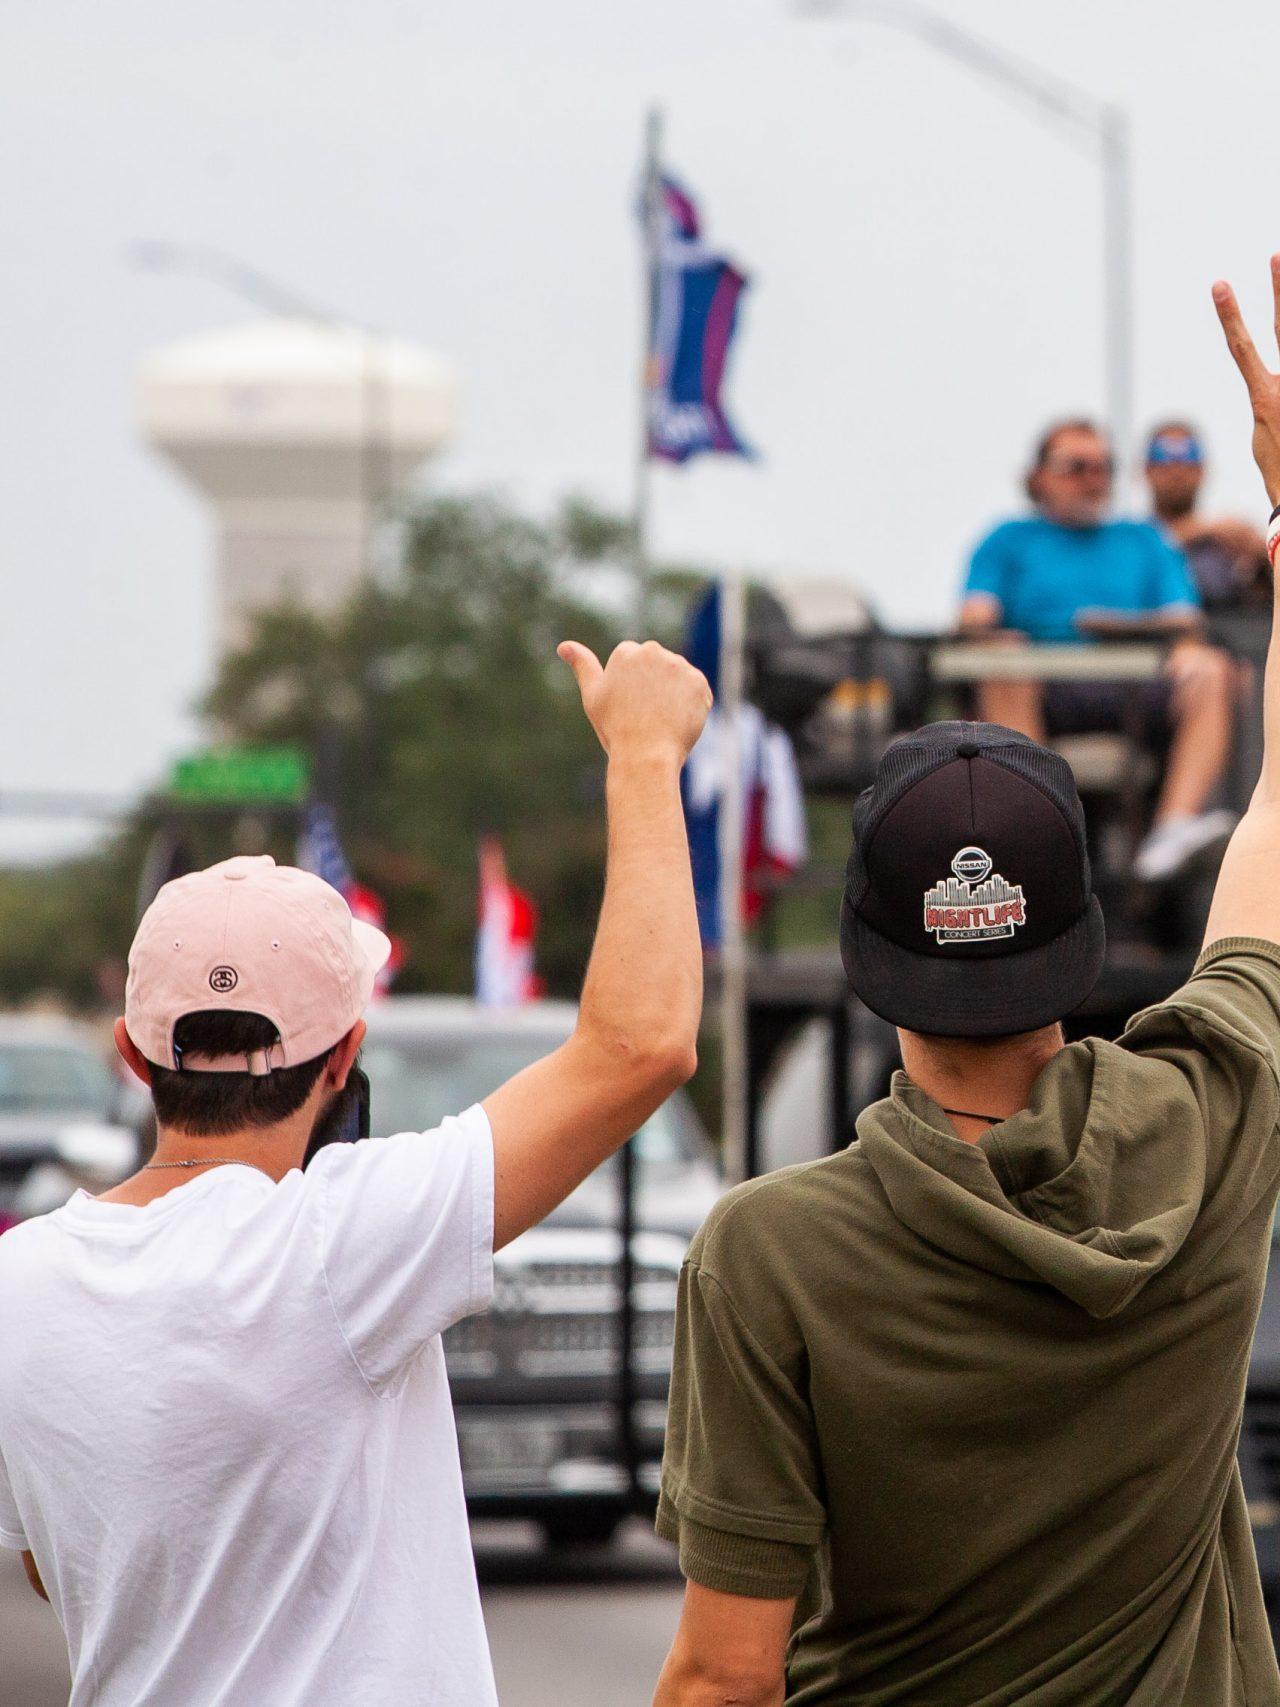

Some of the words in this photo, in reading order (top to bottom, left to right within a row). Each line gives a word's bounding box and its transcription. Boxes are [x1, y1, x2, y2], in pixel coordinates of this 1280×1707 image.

[926, 901, 1023, 928] NIGHTLIFE
[944, 930, 981, 938] CONCERT
[982, 927, 1007, 937] SERIES
